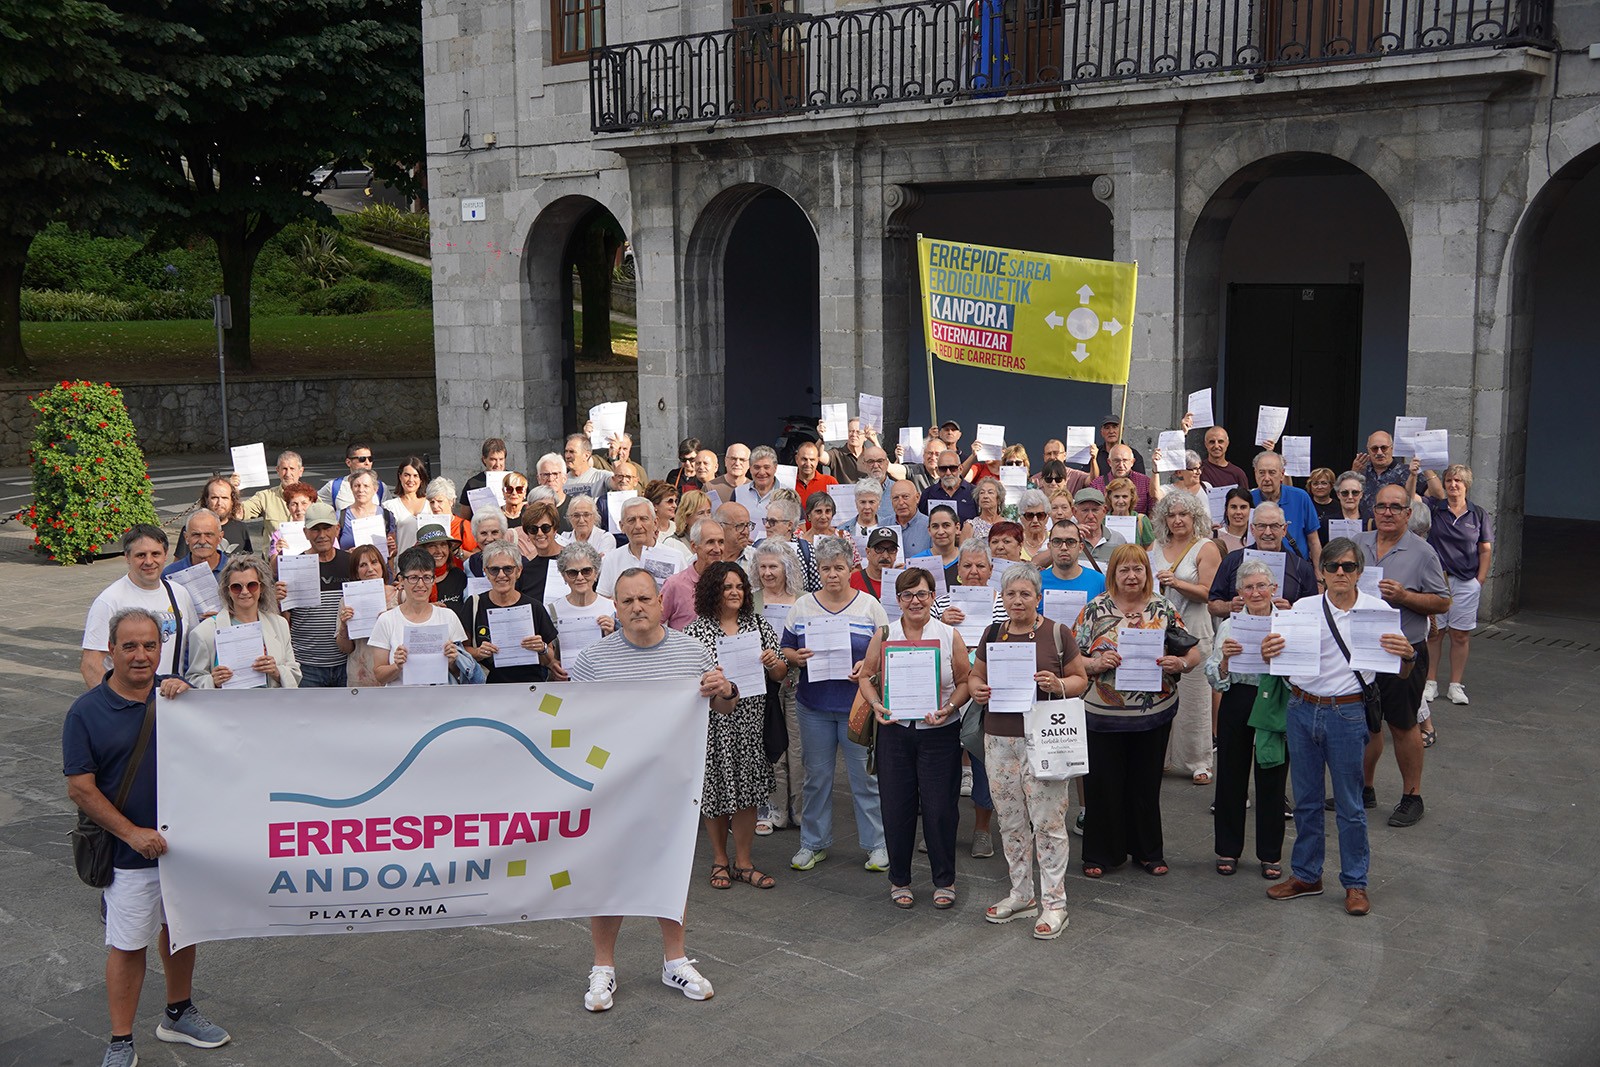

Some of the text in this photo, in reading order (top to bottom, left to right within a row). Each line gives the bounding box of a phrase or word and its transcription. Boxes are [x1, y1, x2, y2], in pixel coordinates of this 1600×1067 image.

[929, 242, 1051, 281] ERREPIDE SAREA
[929, 267, 1032, 304] ERDIGUNETIK
[931, 294, 1008, 330] KANPORA
[933, 322, 1007, 351] EXTERNALIZAR
[939, 343, 952, 358] RED
[954, 347, 964, 361] DE
[967, 349, 1026, 370] CARRETERAS
[1041, 727, 1077, 737] SALKIN
[268, 808, 591, 858] ERRESPETATU
[268, 858, 491, 894] ANDOAIN
[309, 903, 448, 920] PLATAFORMA
